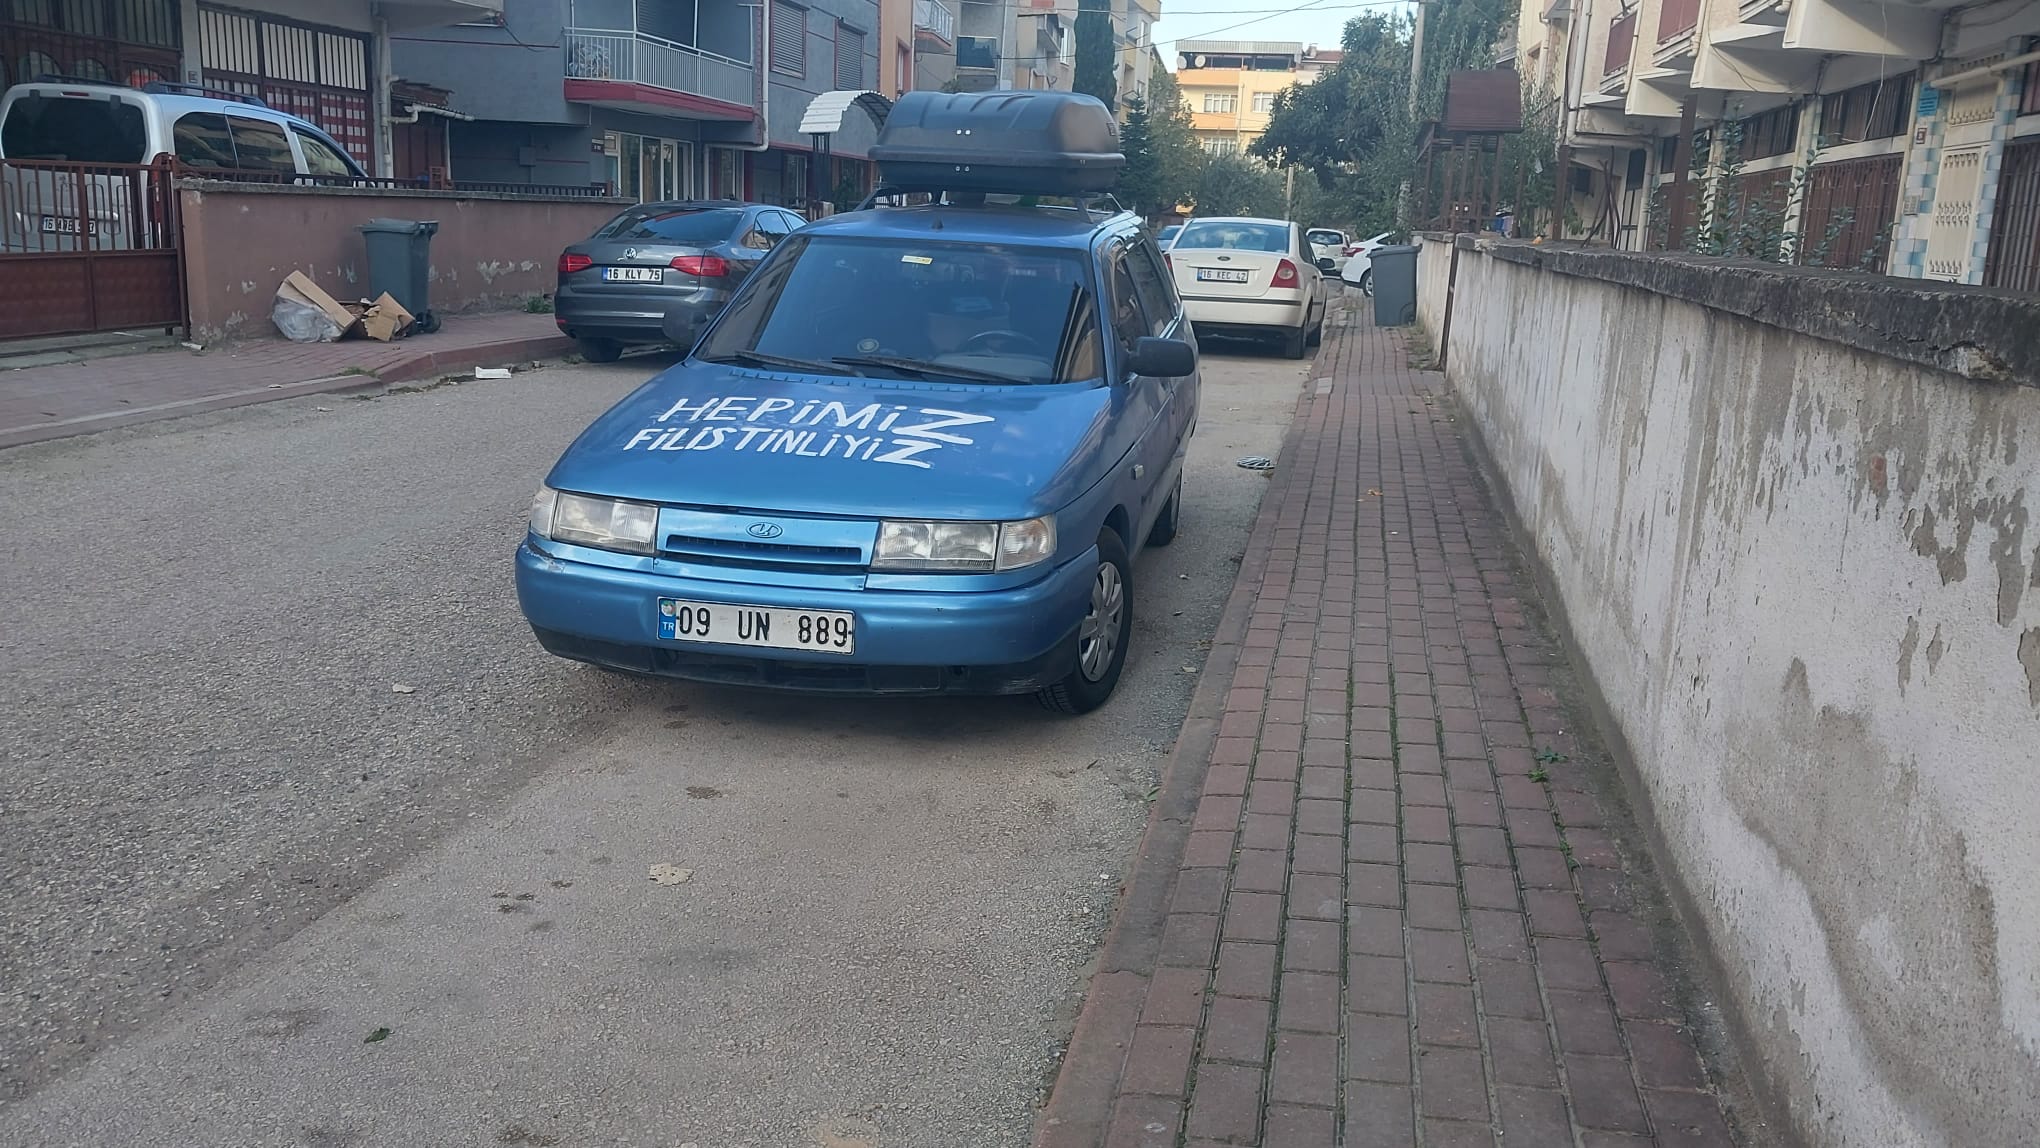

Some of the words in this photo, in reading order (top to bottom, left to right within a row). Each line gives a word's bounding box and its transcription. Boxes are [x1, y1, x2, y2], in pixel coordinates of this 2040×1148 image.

[609, 269, 619, 279] 16
[625, 269, 642, 279] KLY
[648, 270, 660, 280] 75
[1203, 270, 1211, 278] 16
[662, 621, 674, 631] TR
[679, 606, 711, 637] 09
[738, 610, 770, 641] UN
[798, 614, 848, 648] 889
